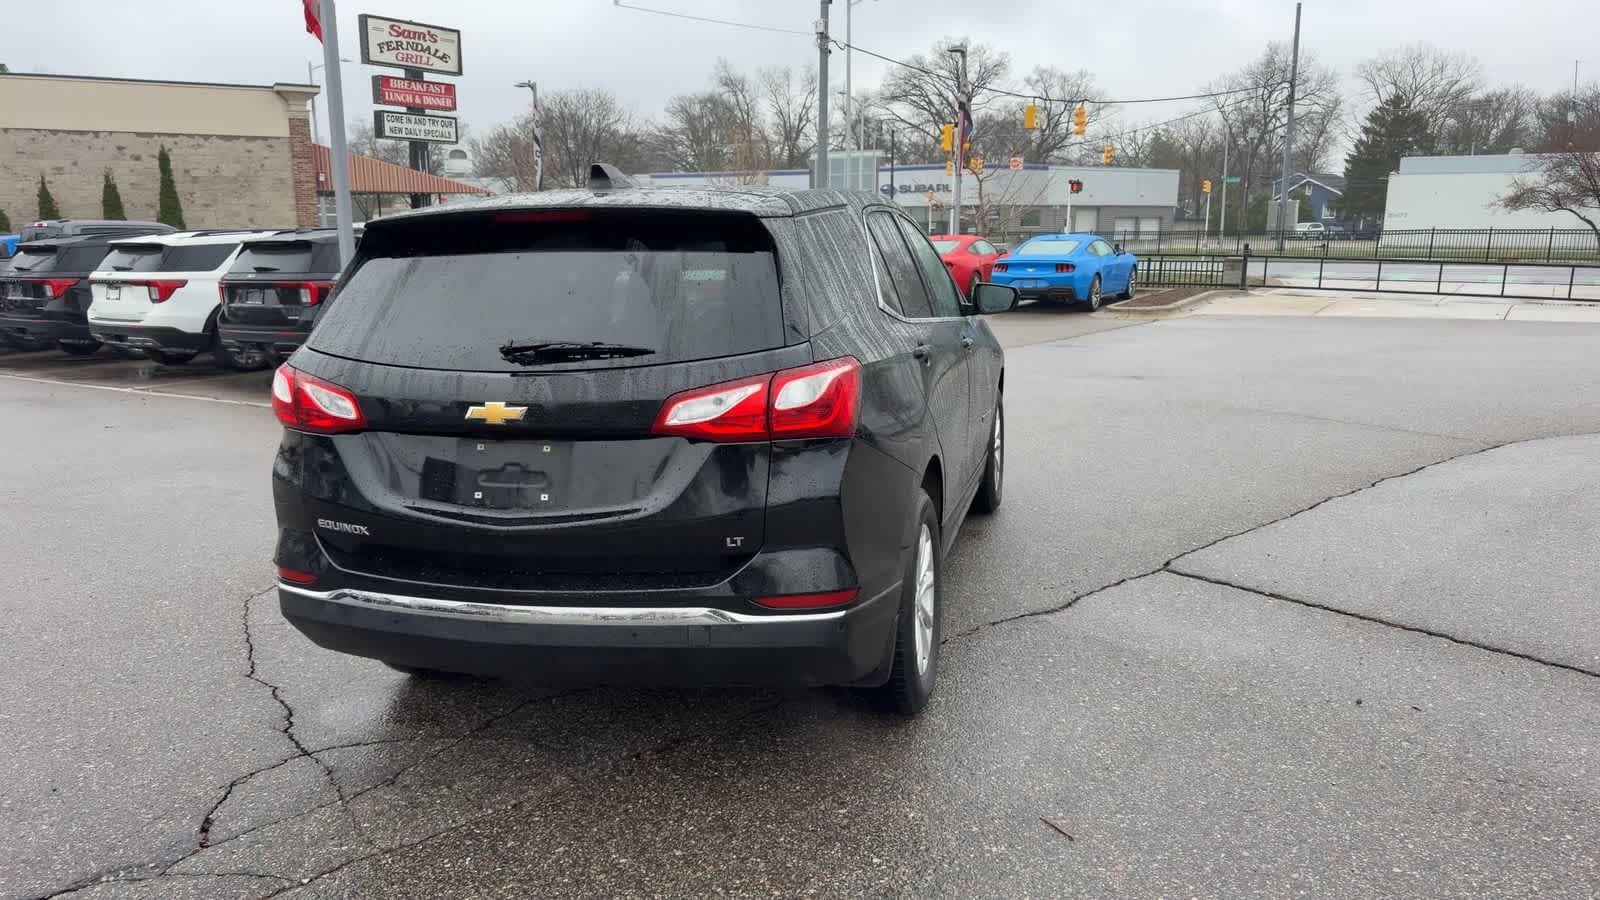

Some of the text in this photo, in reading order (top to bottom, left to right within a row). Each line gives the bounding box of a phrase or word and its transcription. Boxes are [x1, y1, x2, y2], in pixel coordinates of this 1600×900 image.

[388, 24, 438, 43] Sam's
[377, 40, 451, 63] FERNDALE
[395, 52, 434, 66] GRILL
[389, 79, 446, 94] BREAKFAST
[385, 91, 452, 107] LUNCH & DINNER
[386, 114, 453, 129] COME IN AND TRY OUR
[389, 126, 452, 139] NEW DAILY SPECIALS
[317, 518, 370, 536] EQUINOX
[726, 536, 745, 547] LT
